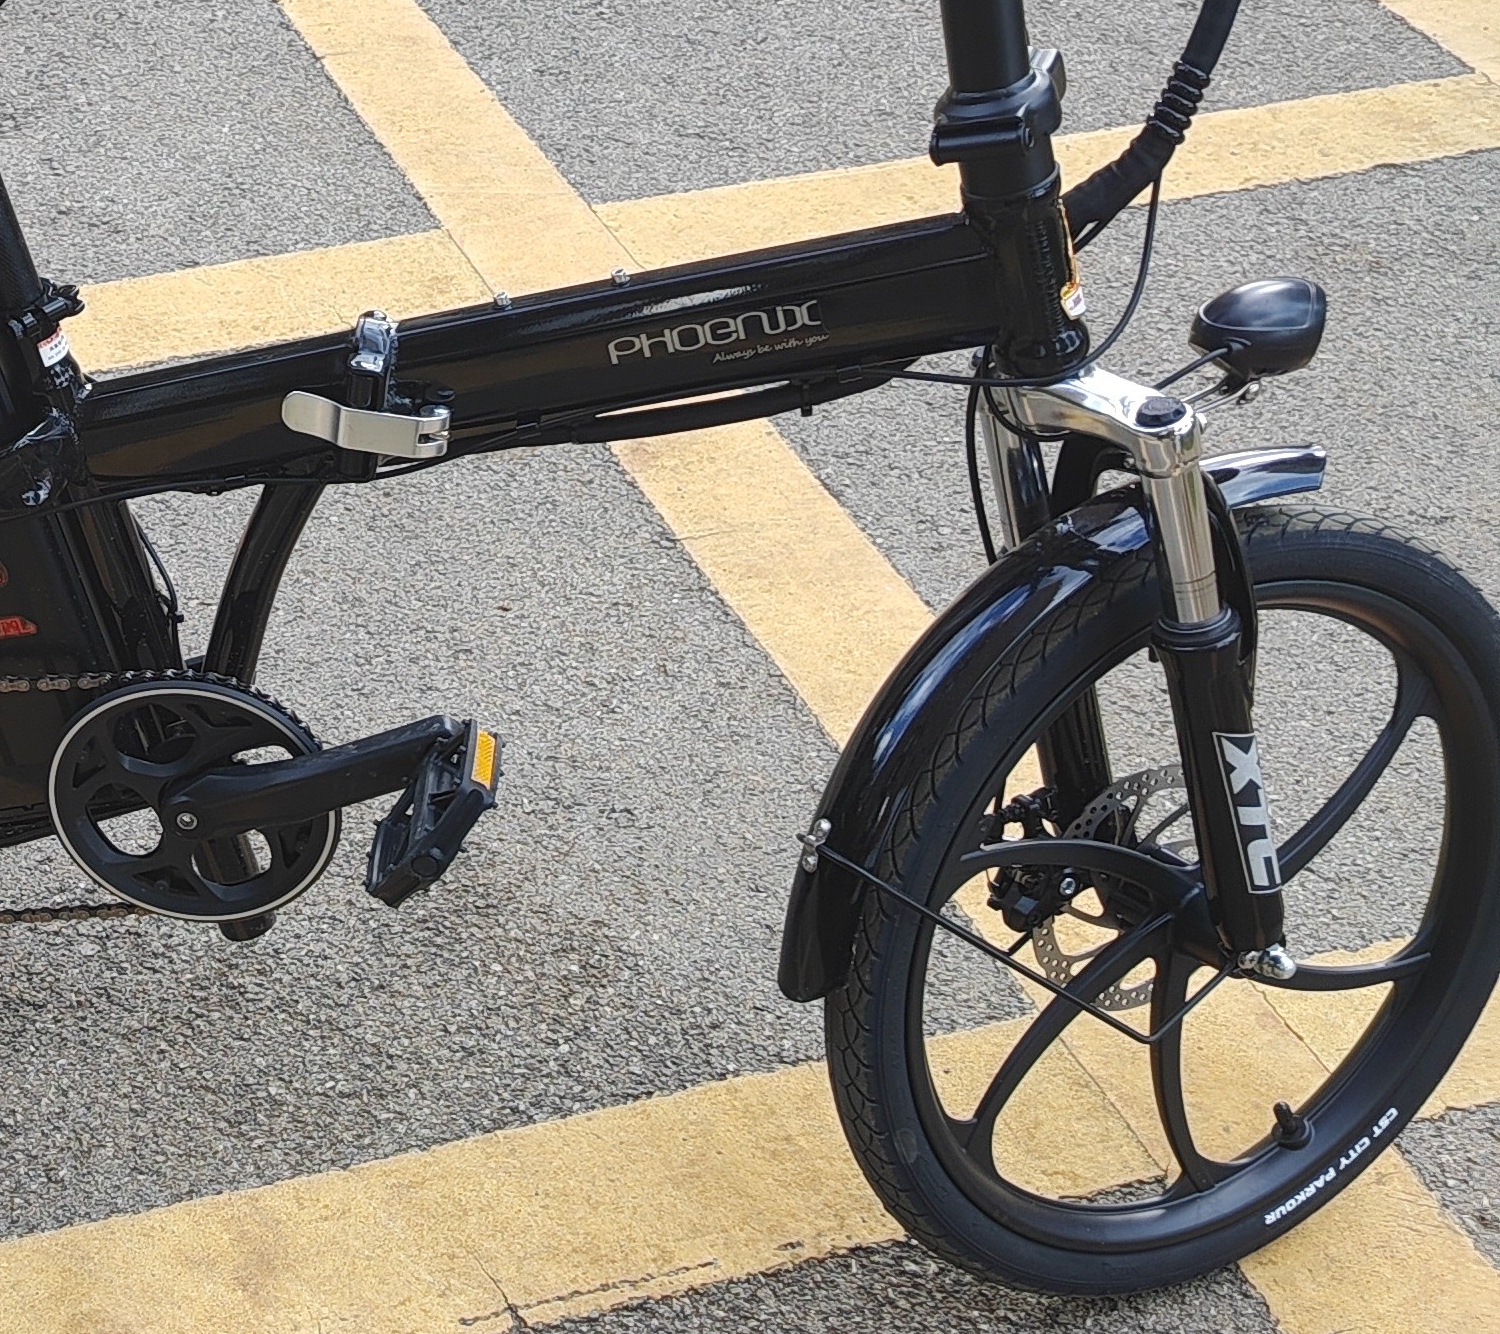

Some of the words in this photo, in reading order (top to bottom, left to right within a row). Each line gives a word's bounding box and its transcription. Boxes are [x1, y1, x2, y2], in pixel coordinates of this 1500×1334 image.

[712, 347, 758, 364] Always
[756, 344, 773, 354] be
[773, 337, 805, 351] with
[804, 333, 831, 347] you
[1372, 1107, 1399, 1138] CST
[1339, 1136, 1371, 1170] CITY
[1264, 1167, 1337, 1225] PARKOUR
